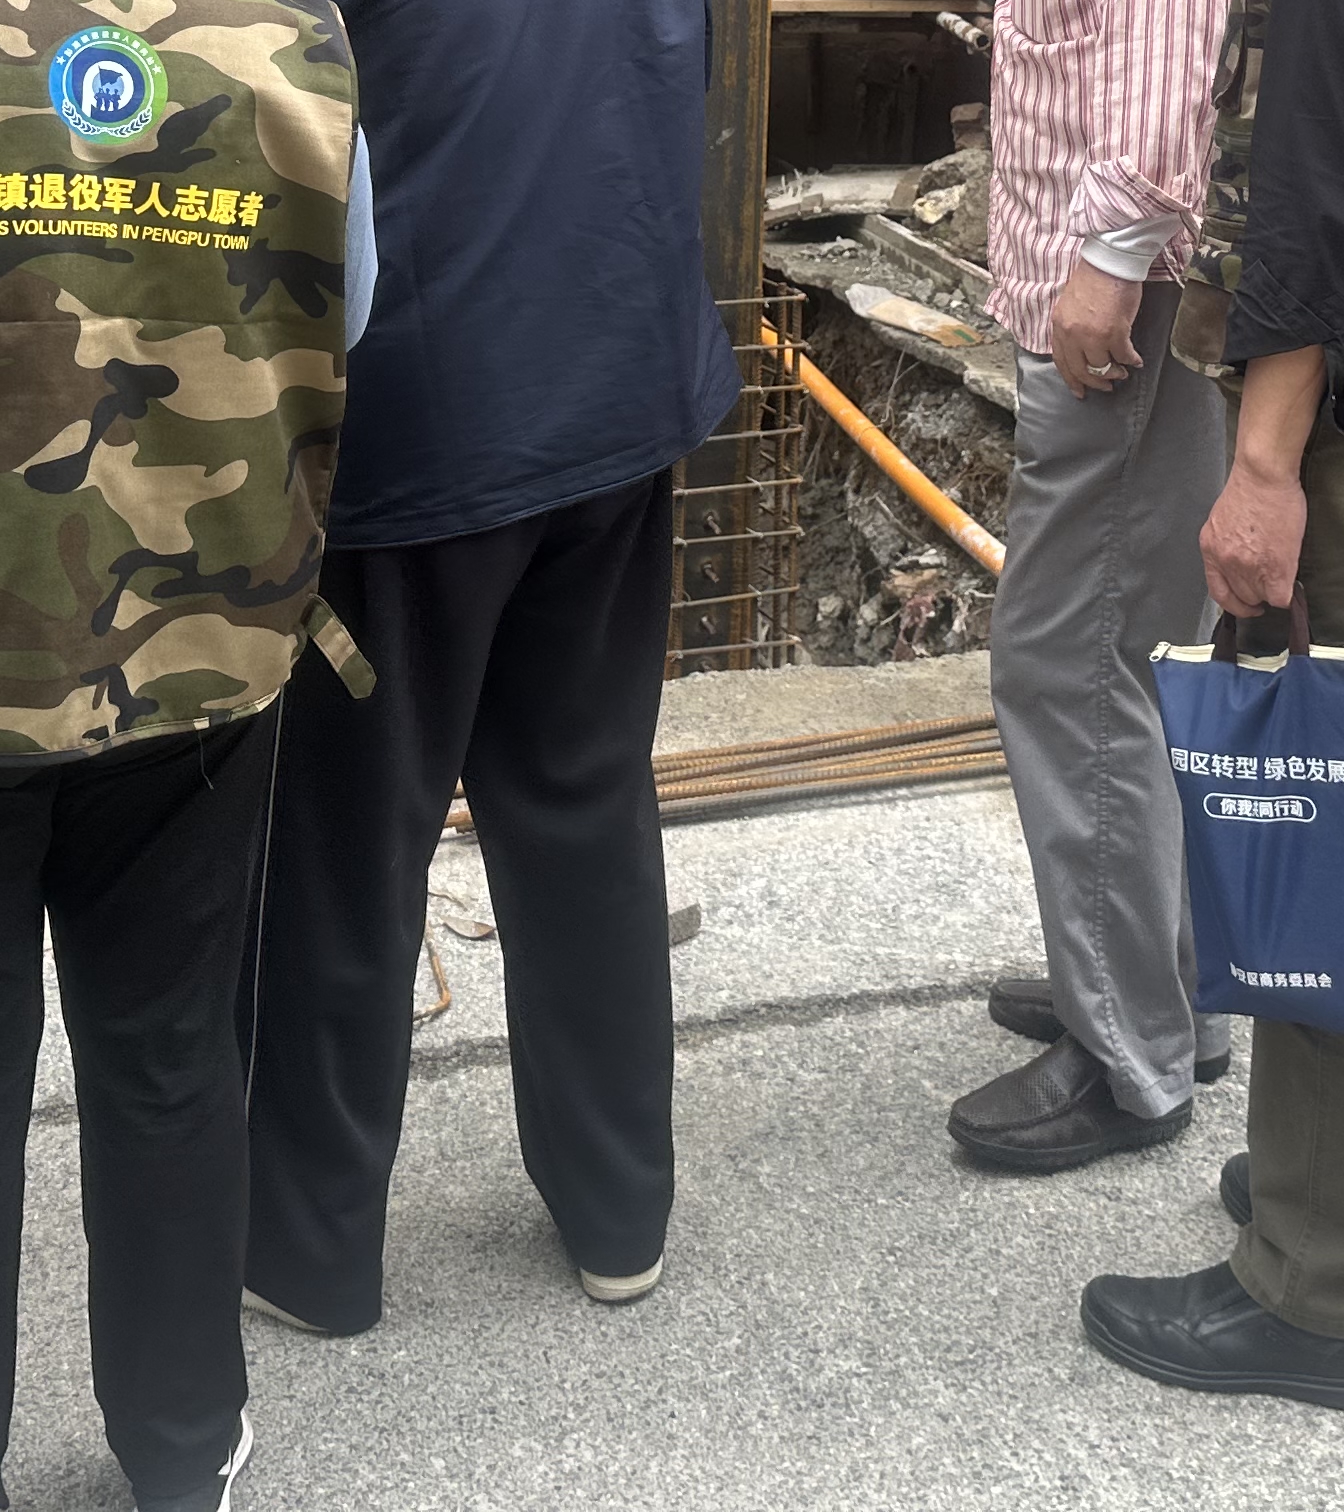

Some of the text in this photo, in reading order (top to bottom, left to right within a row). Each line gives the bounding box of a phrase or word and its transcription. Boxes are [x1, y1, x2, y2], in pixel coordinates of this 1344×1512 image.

[12, 220, 118, 238] VOLUNTEERS
[122, 225, 139, 239] IN
[142, 226, 210, 247] PENGPU
[213, 233, 250, 250] TOWN
[1170, 747, 1258, 781] 园区转型
[1229, 961, 1333, 988] 安区商务委员会
